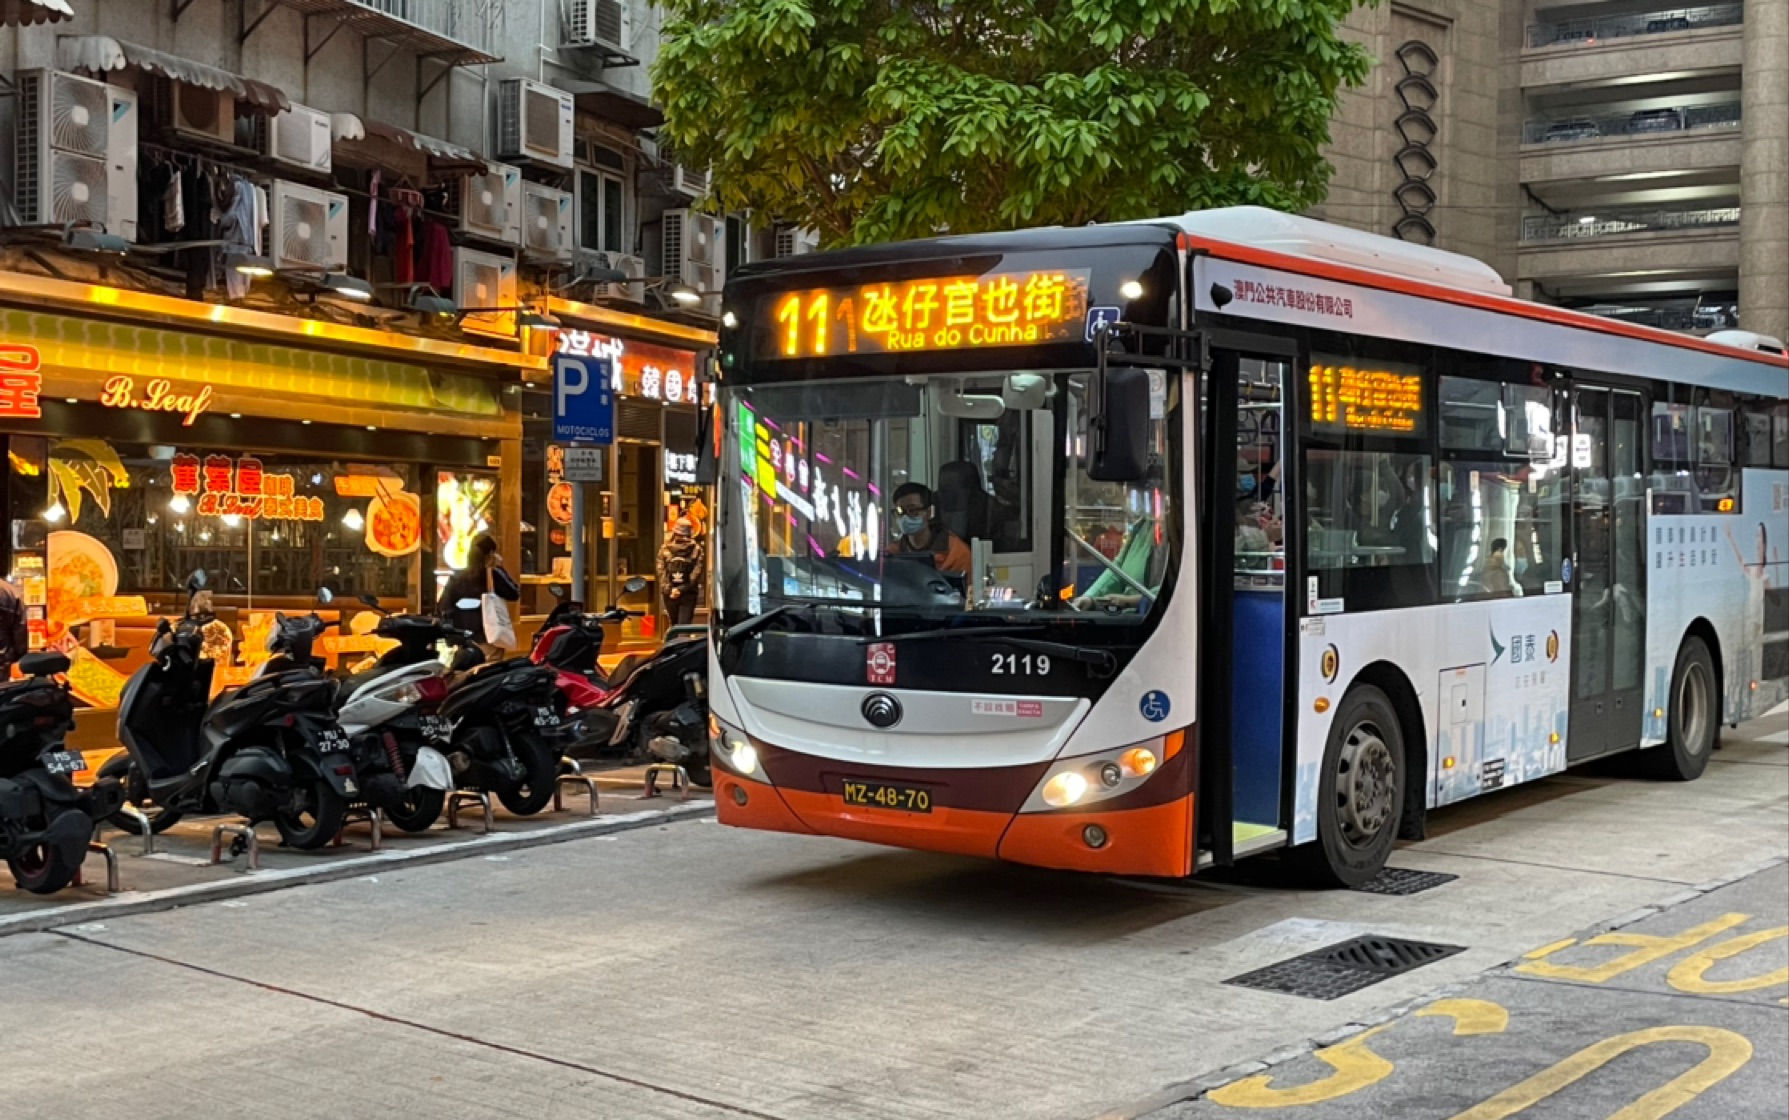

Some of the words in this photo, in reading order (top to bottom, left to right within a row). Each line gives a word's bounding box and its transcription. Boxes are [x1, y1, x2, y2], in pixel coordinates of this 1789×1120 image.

[1233, 279, 1353, 319] 澳門公共汽車股份有限公司
[779, 293, 829, 355] 11
[862, 273, 1065, 333] 氹仔官也街
[887, 330, 925, 350] Rua
[934, 327, 961, 347] do
[969, 324, 1038, 344] Cunha
[557, 358, 589, 417] P
[1309, 366, 1335, 422] 11
[557, 424, 610, 437] MOTOCICLOS
[1510, 633, 1536, 664] 國泰
[991, 653, 1051, 675] 2119
[319, 738, 350, 753] 27-30
[47, 760, 84, 774] 54-67
[844, 783, 930, 809] MZ-48-70
